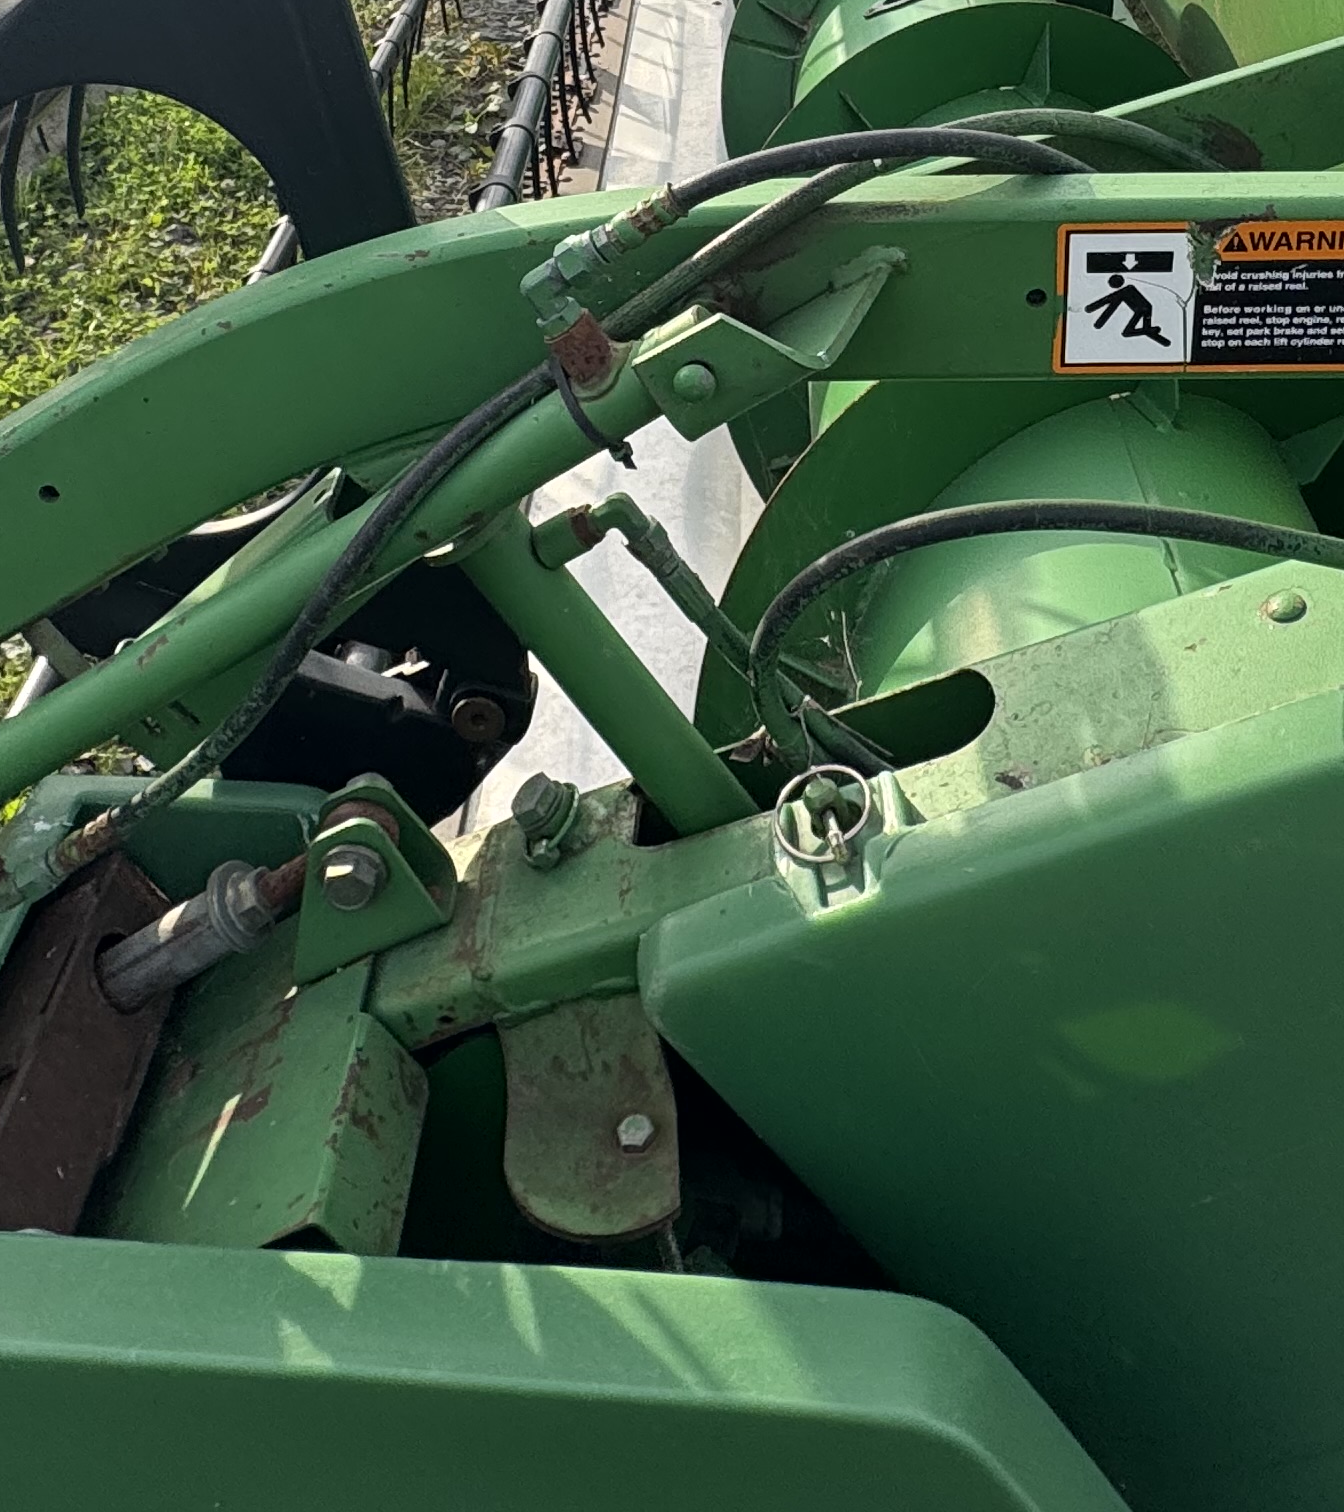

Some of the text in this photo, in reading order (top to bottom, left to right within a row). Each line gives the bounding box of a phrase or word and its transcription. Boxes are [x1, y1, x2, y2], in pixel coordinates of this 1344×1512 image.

[1240, 270, 1290, 281] crushing
[1224, 282, 1236, 291] of
[1248, 282, 1283, 291] raised
[1203, 304, 1241, 314] Before
[1243, 304, 1292, 315] working
[1202, 316, 1237, 325] raised
[1265, 316, 1291, 326] stop
[1226, 327, 1244, 336] set
[1245, 327, 1271, 338] park
[1273, 327, 1304, 336] brake
[1306, 326, 1327, 336] and
[1201, 339, 1226, 349] stop
[1227, 339, 1243, 347] on
[1244, 338, 1272, 347] each
[1273, 337, 1289, 347] lift
[1290, 337, 1335, 348] cylinder
